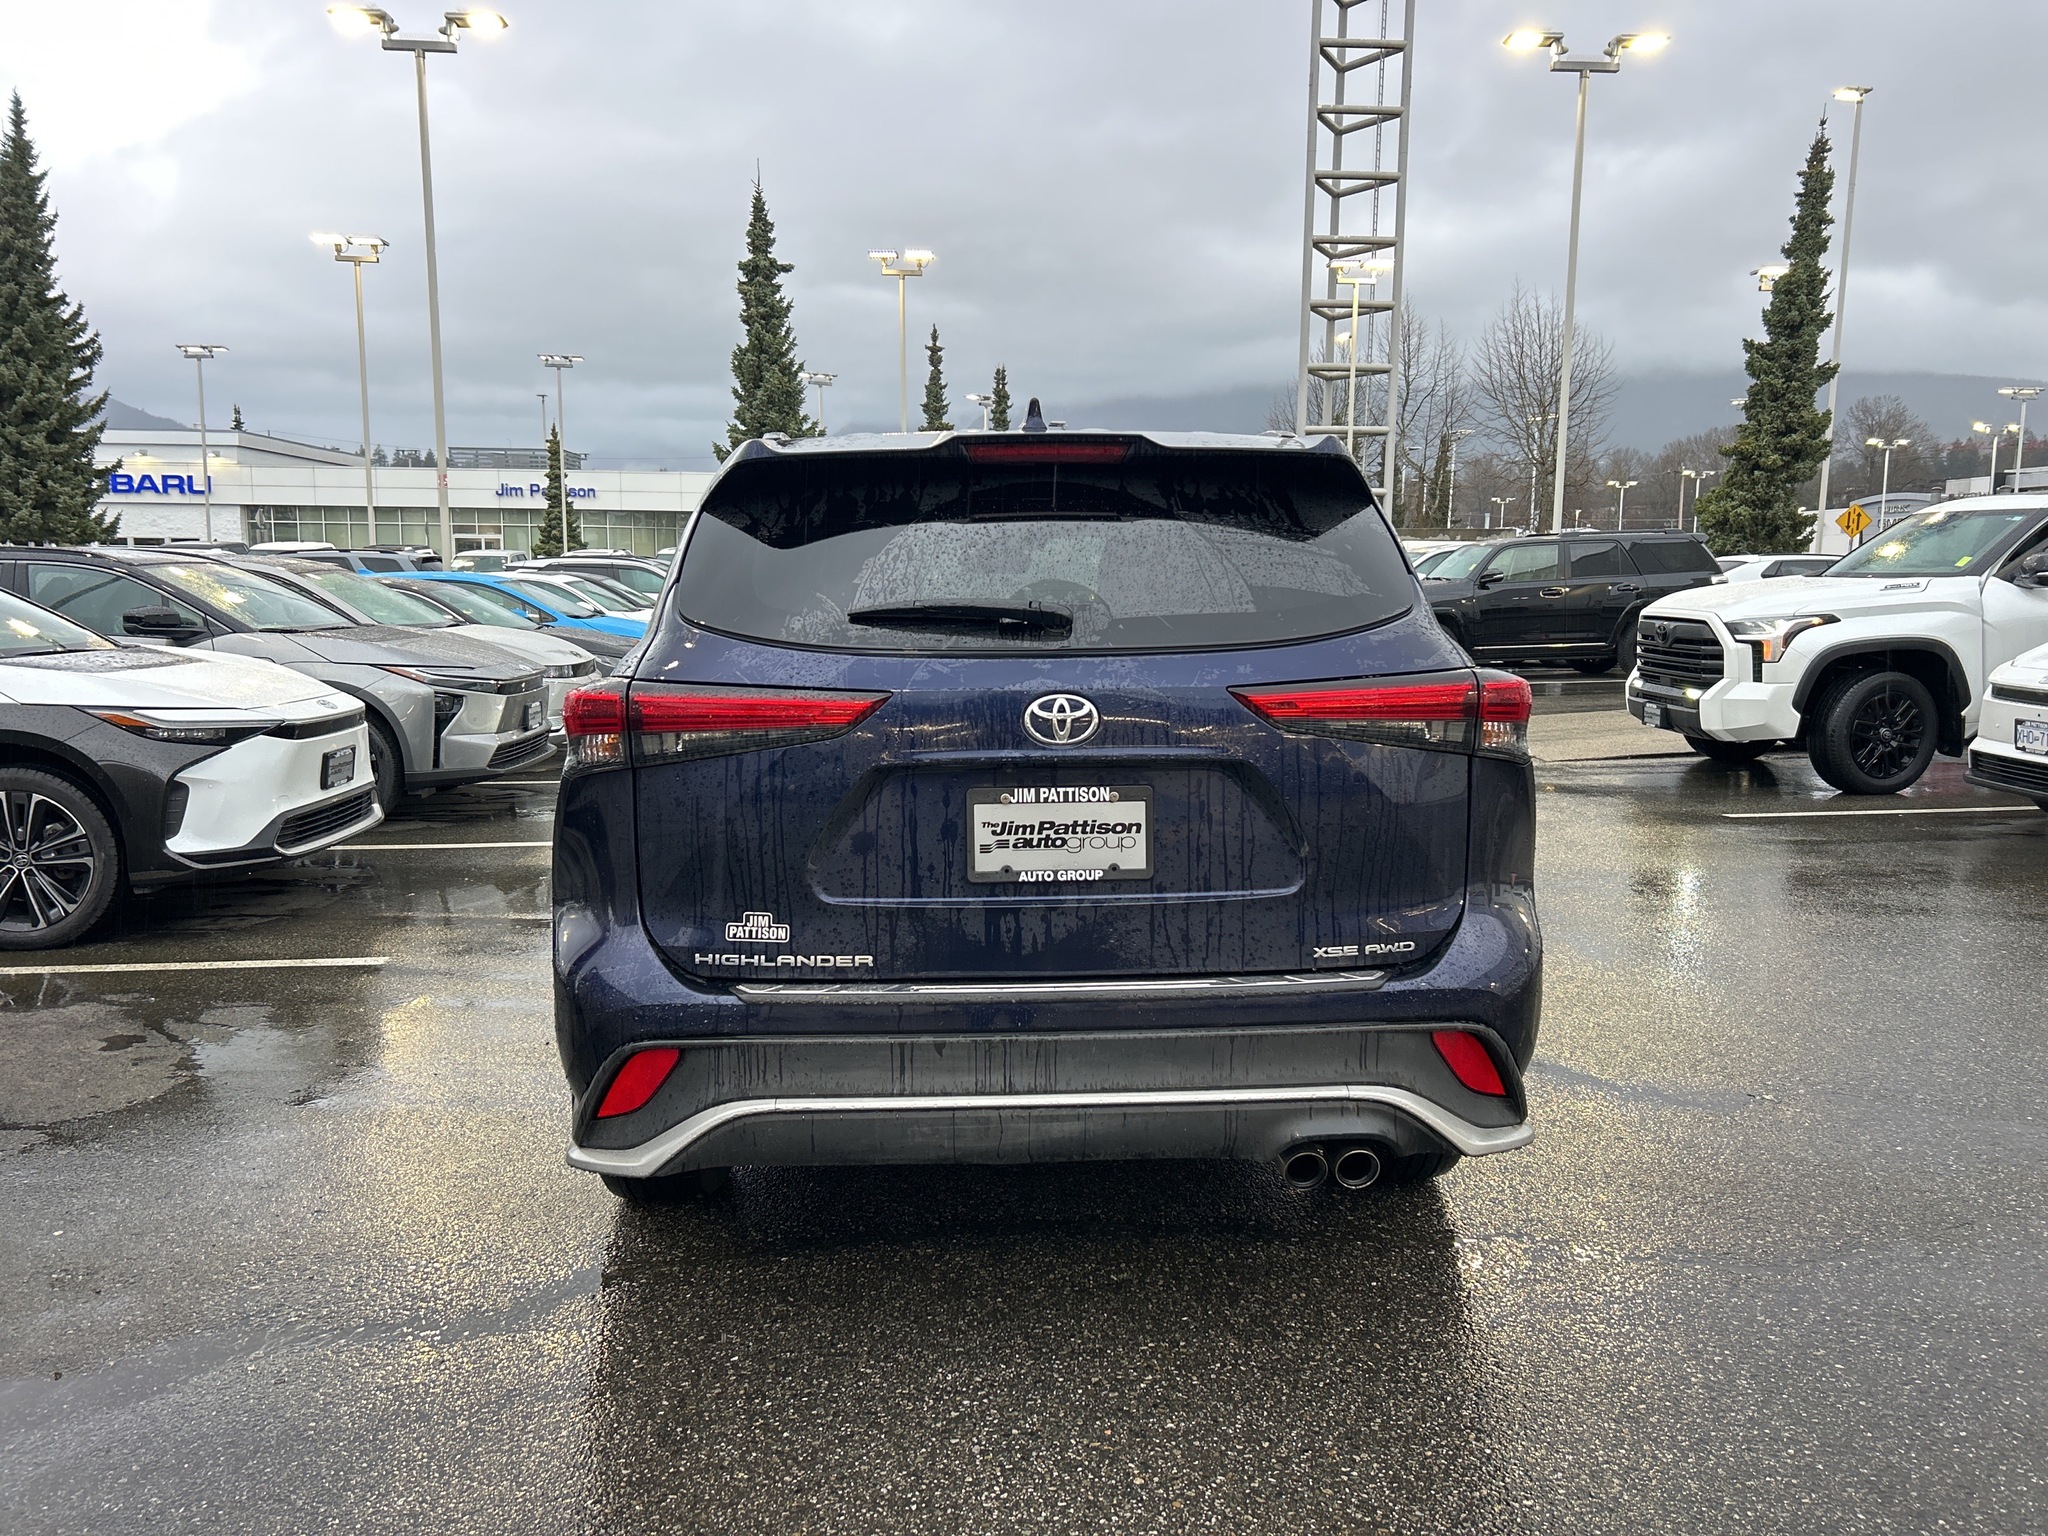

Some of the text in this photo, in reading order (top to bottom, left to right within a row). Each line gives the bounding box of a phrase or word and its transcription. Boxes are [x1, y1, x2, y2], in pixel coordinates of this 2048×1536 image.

[110, 473, 211, 494] BARU
[496, 483, 523, 497] Jim
[1010, 787, 1110, 803] JIM PATTISON
[981, 820, 1142, 836] The Jim Pattison
[1018, 870, 1104, 882] AUTO GROUP
[746, 915, 769, 927] JIM
[729, 926, 786, 940] PATTISON
[1313, 941, 1416, 958] XSE AWD
[694, 953, 874, 967] HIGHLANDER
